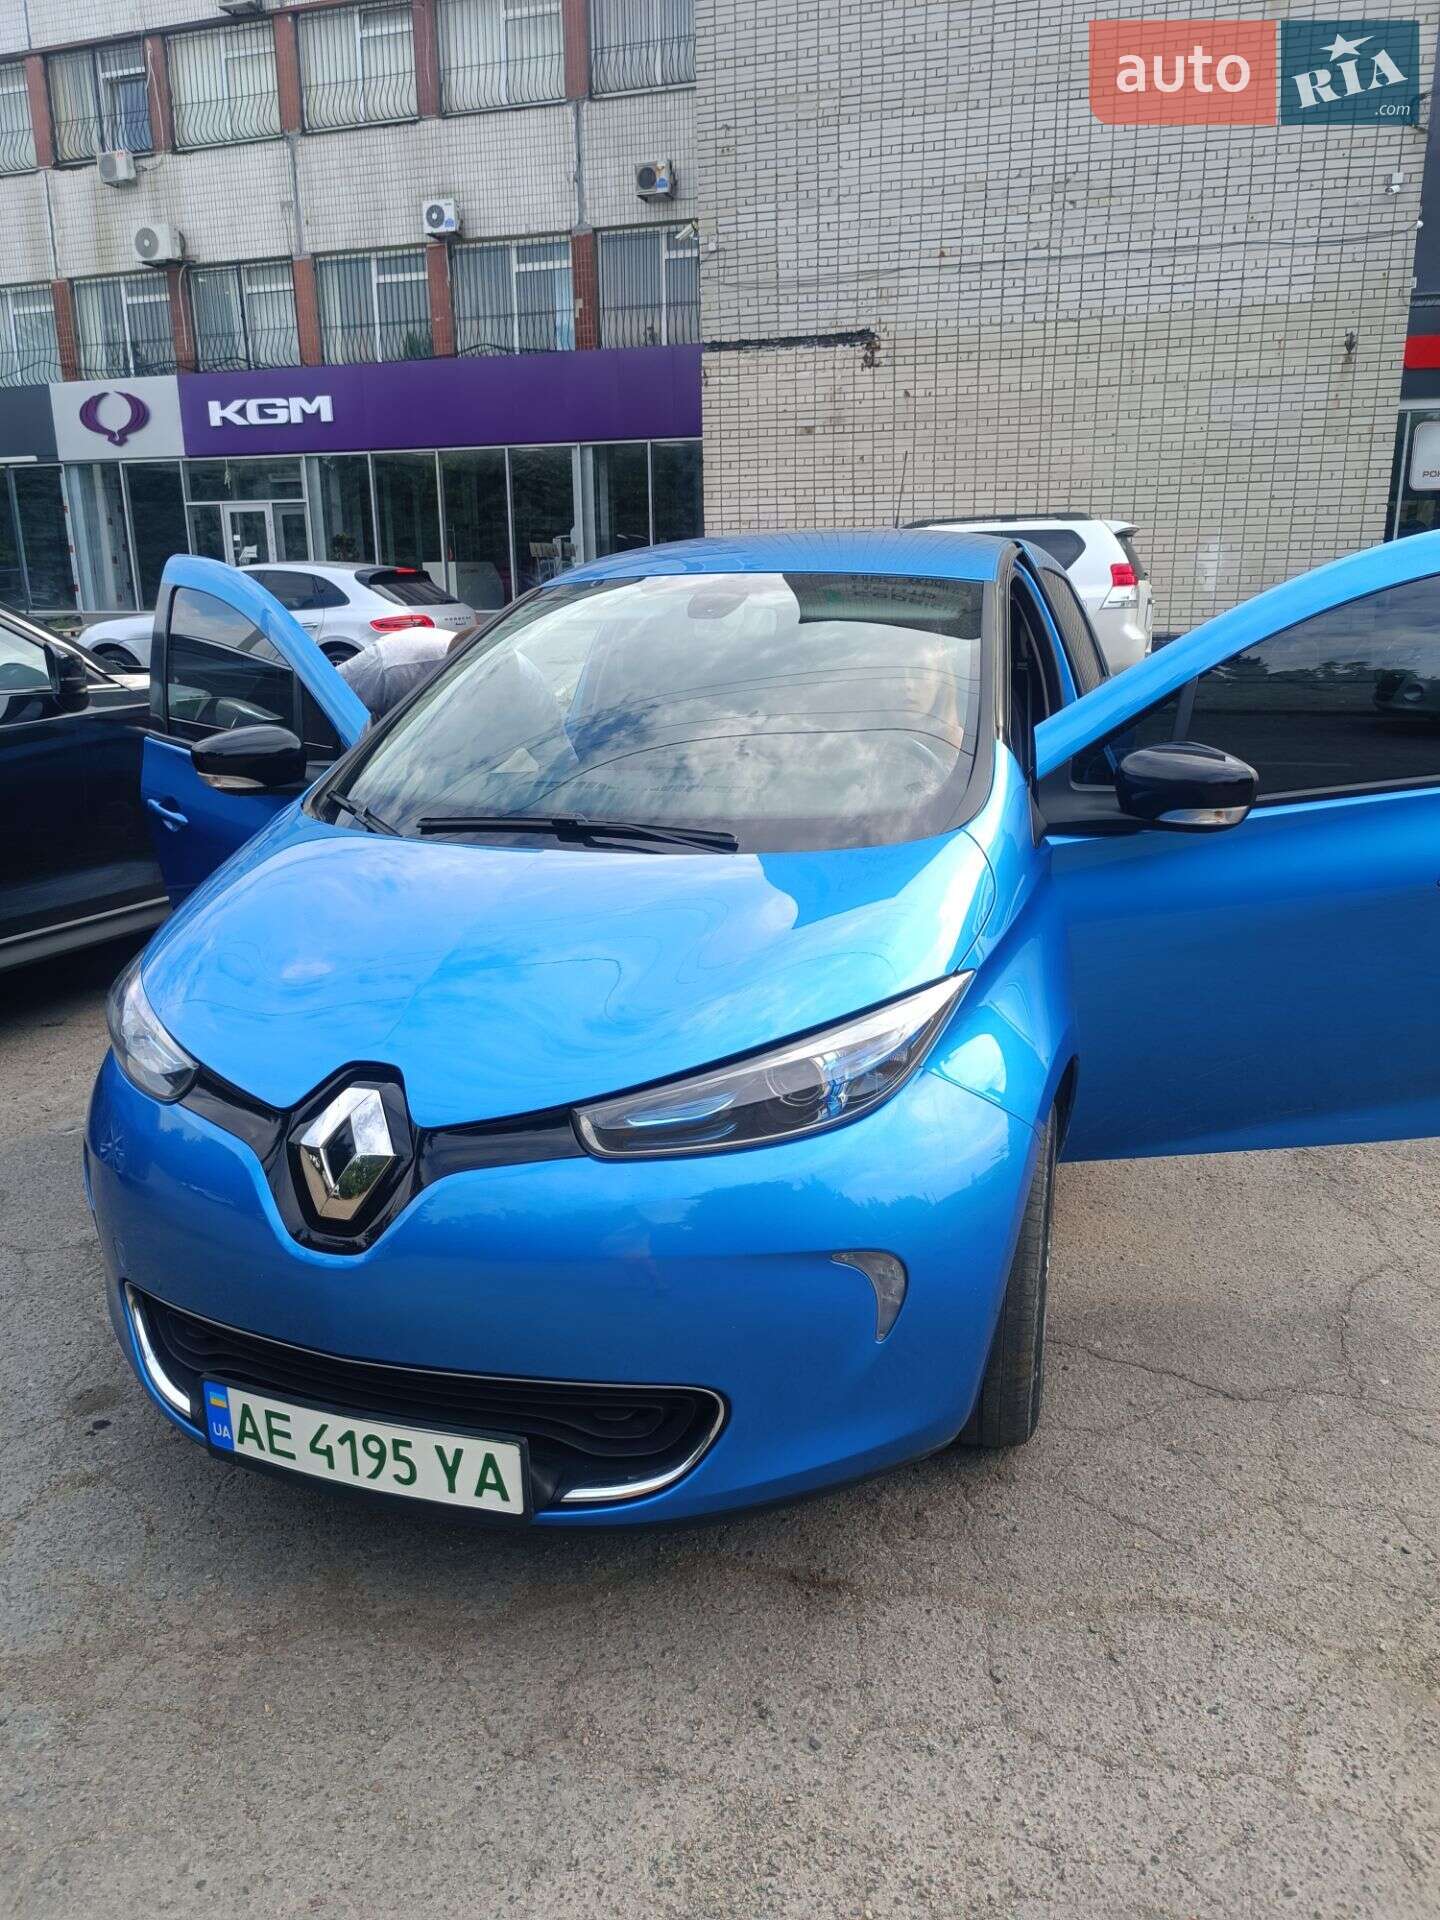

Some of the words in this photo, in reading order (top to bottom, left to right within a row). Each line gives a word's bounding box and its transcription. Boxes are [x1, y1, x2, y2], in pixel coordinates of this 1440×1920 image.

[207, 395, 335, 427] KGM
[212, 1421, 232, 1440] UA
[237, 1403, 297, 1461] AE
[309, 1423, 418, 1486] 4195
[434, 1444, 511, 1502] YA
